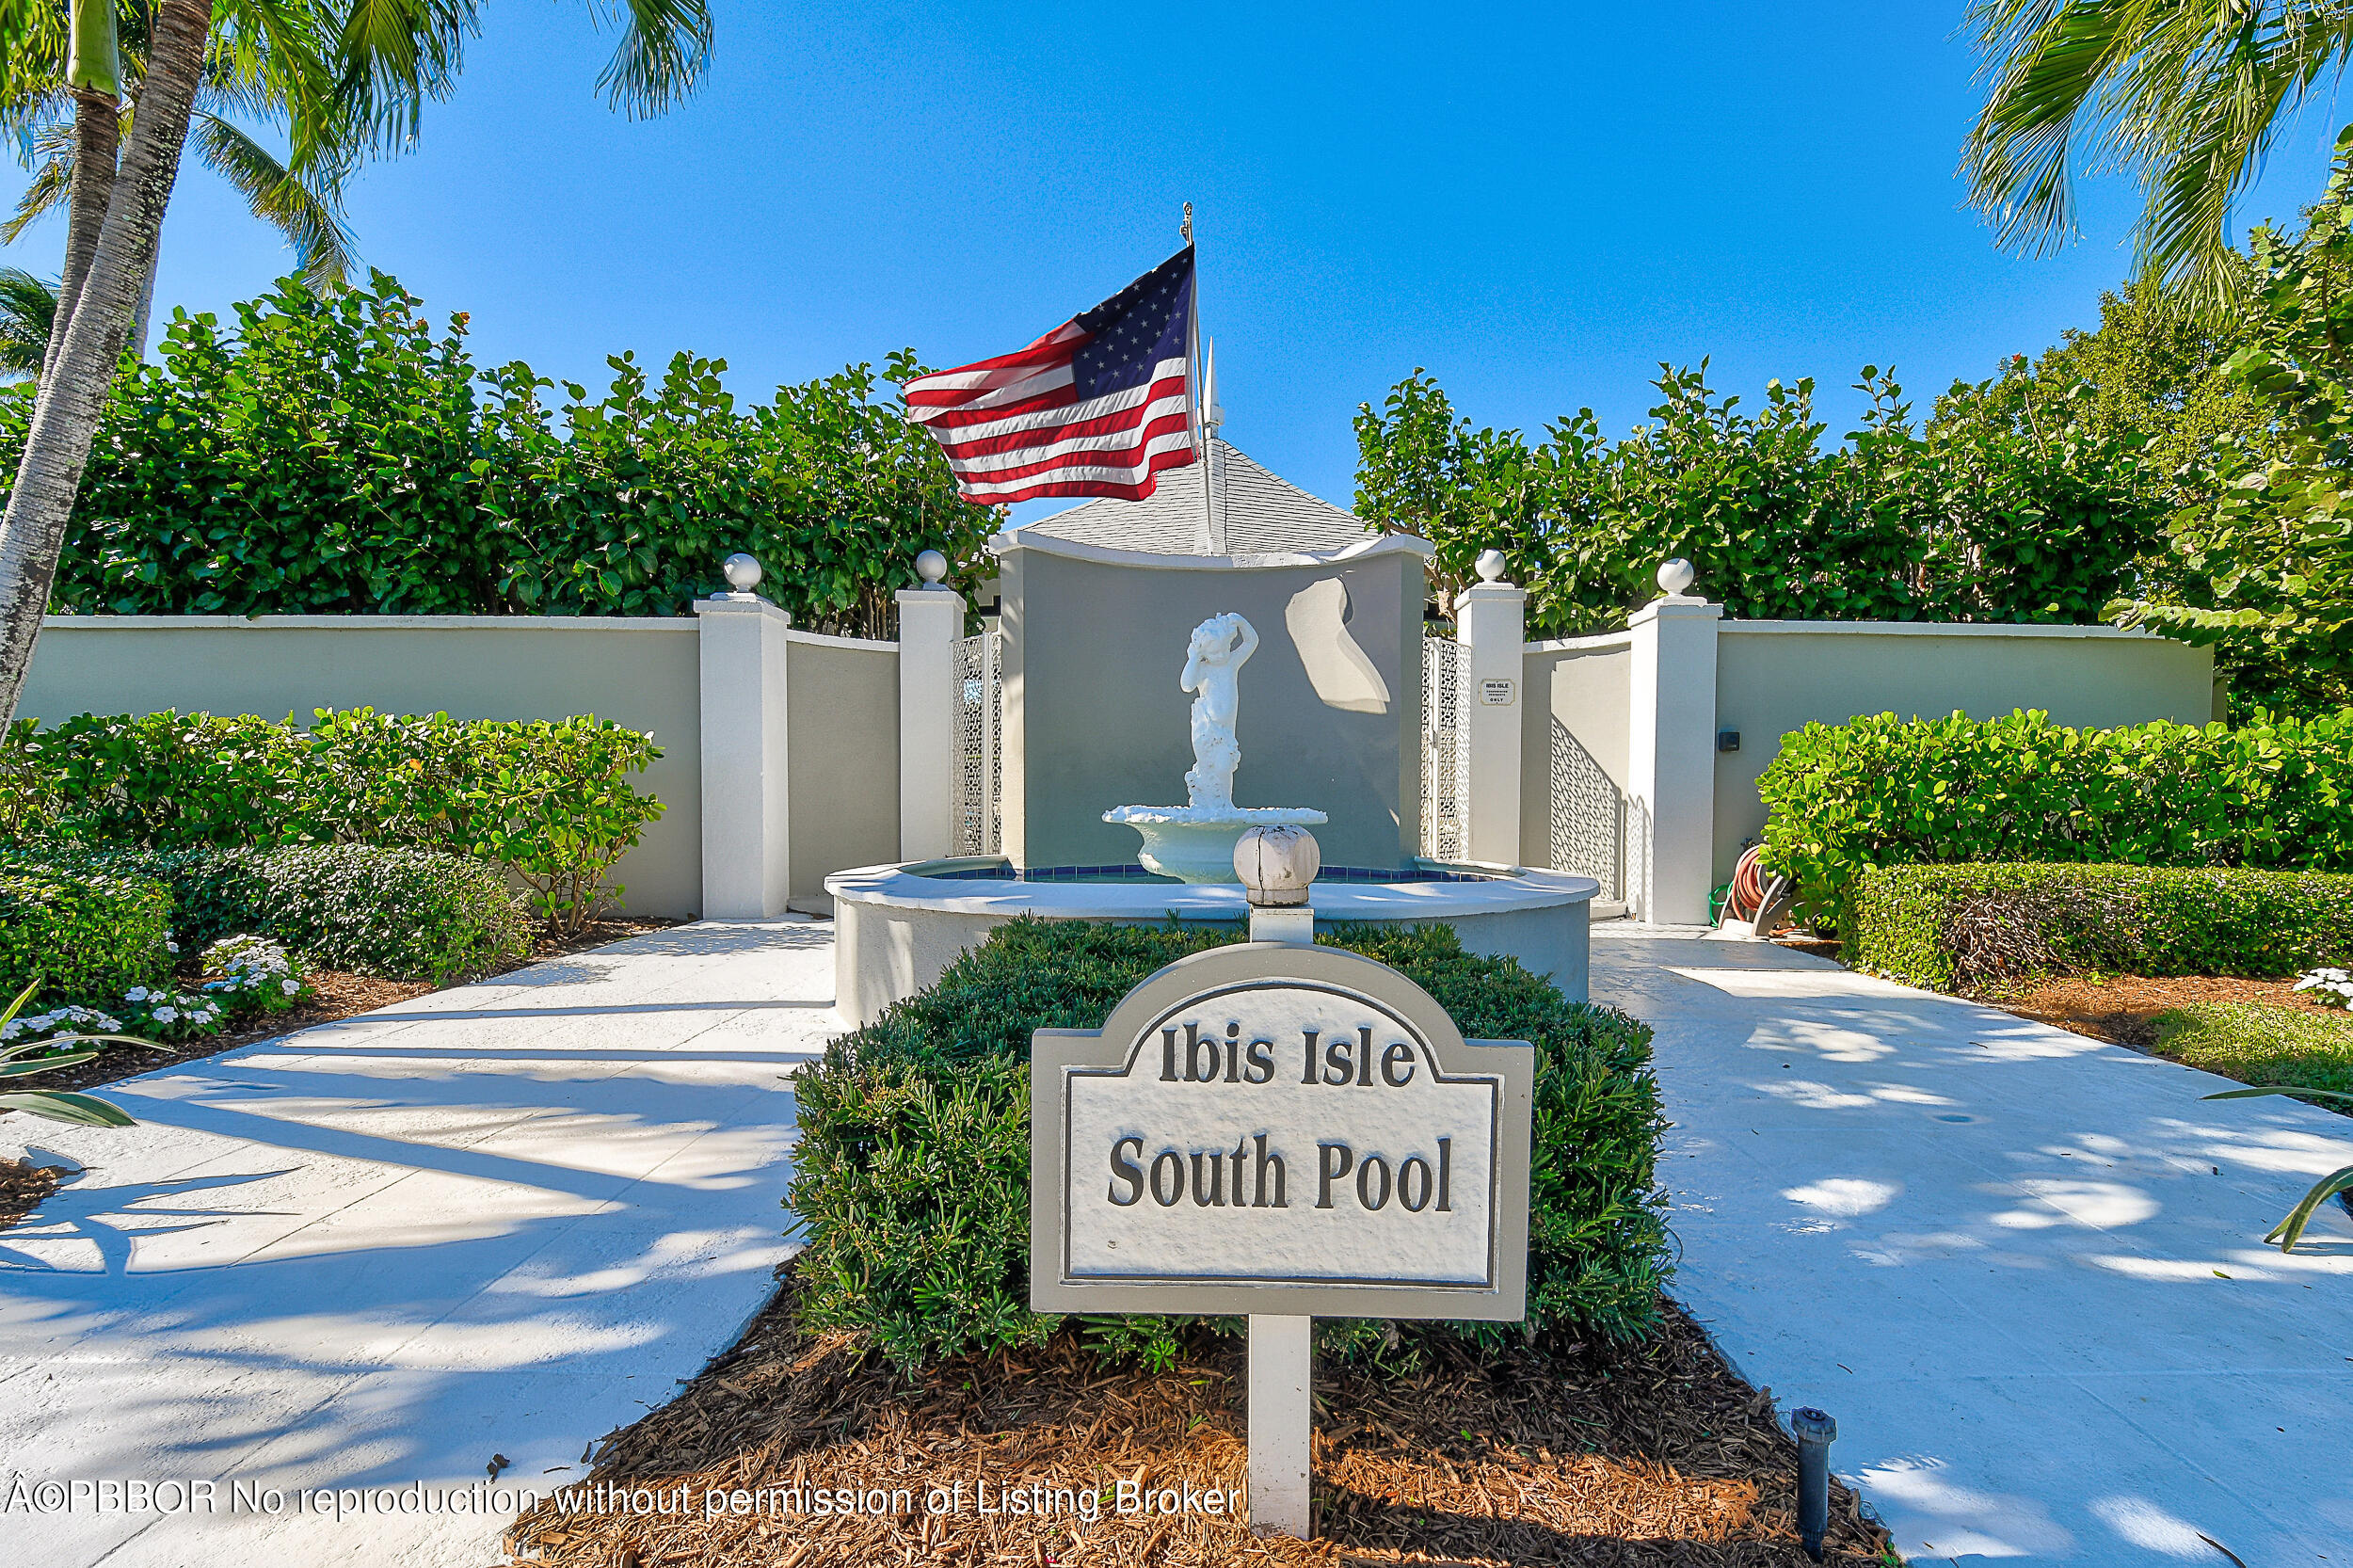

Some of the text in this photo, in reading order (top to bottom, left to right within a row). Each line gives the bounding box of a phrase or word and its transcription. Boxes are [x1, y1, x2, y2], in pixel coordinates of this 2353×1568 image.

[1159, 1021, 1416, 1088] Ibis Isle
[1107, 1135, 1452, 1212] South Pool
